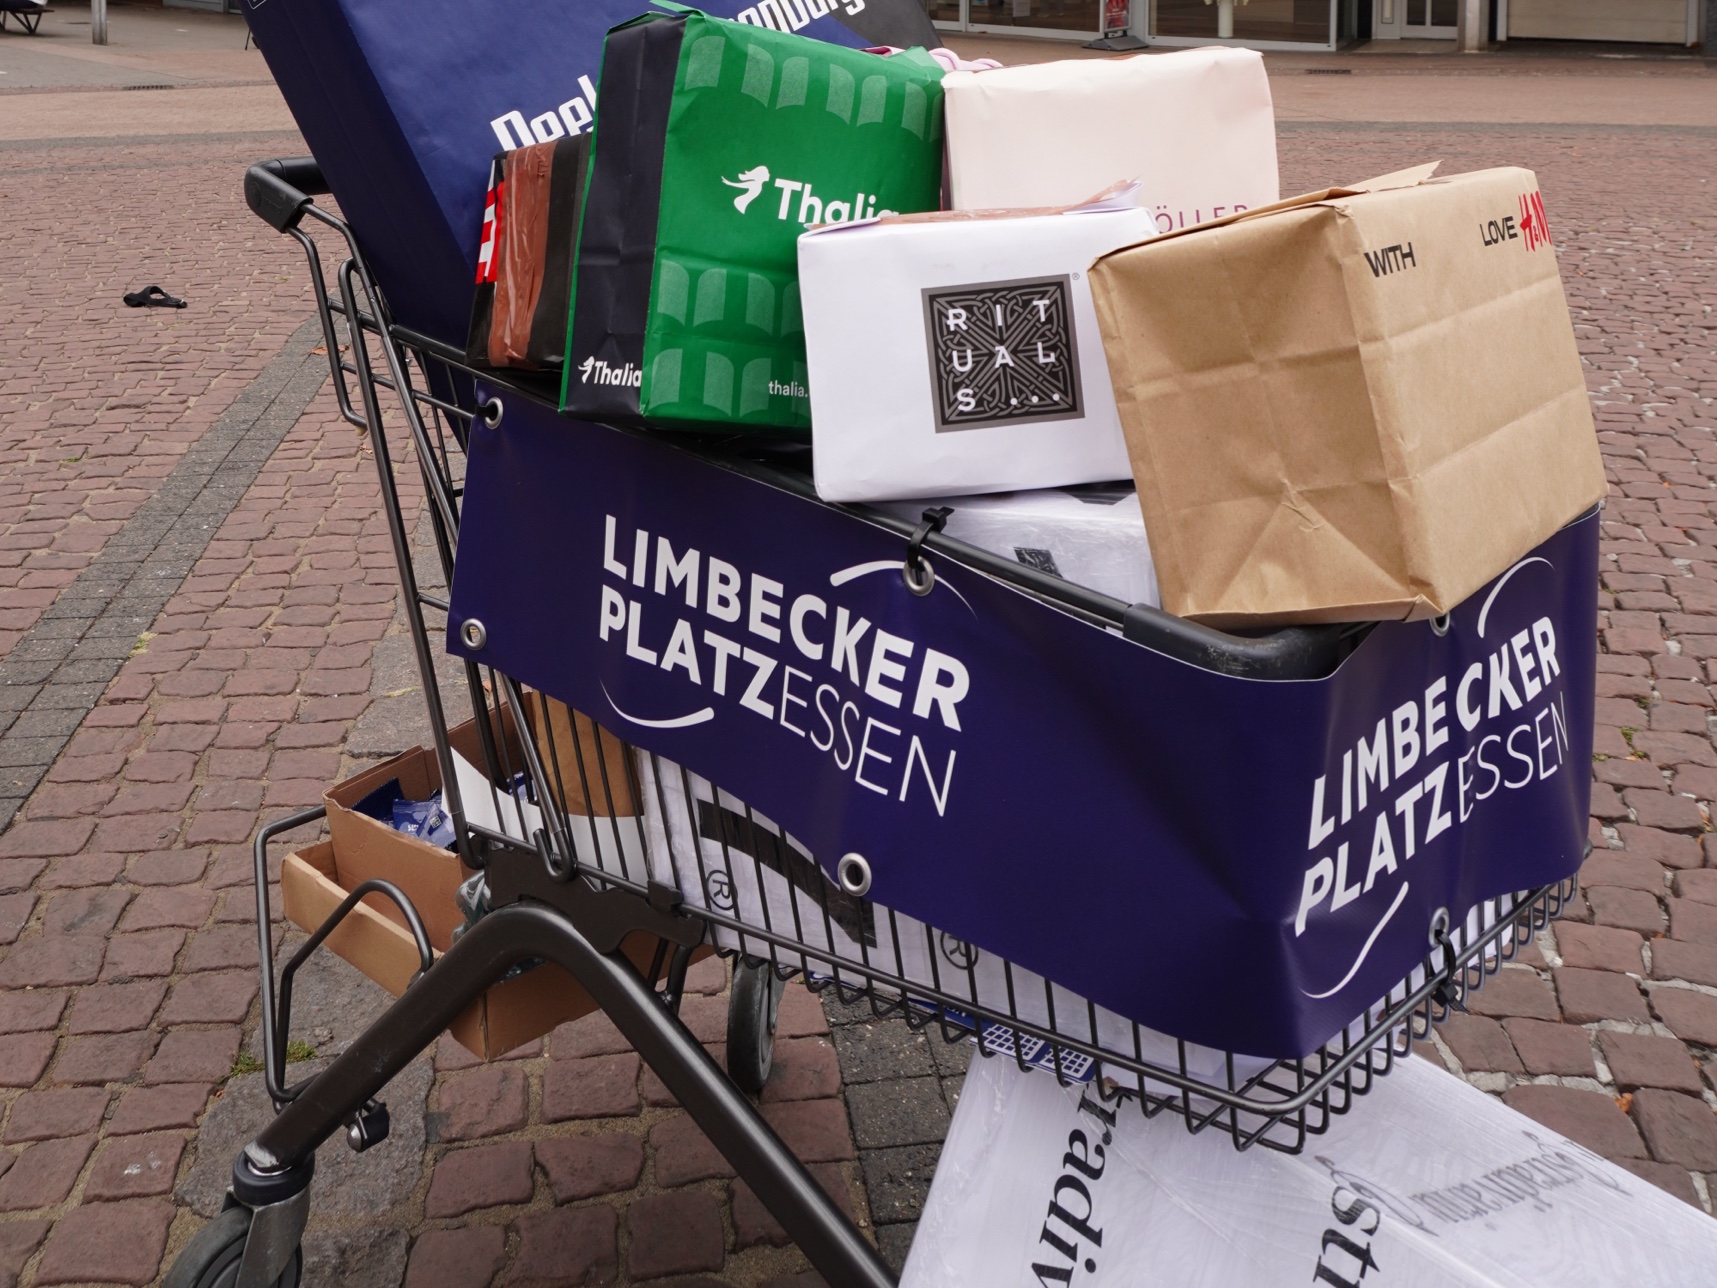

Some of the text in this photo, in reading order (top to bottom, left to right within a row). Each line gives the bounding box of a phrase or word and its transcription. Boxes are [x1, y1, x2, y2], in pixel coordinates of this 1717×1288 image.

[1364, 242, 1416, 277] WITH
[1479, 216, 1518, 246] LOVE
[593, 361, 642, 388] Thalia
[603, 514, 970, 732] LIMBECKER
[1308, 616, 1561, 850] LIMBECKER
